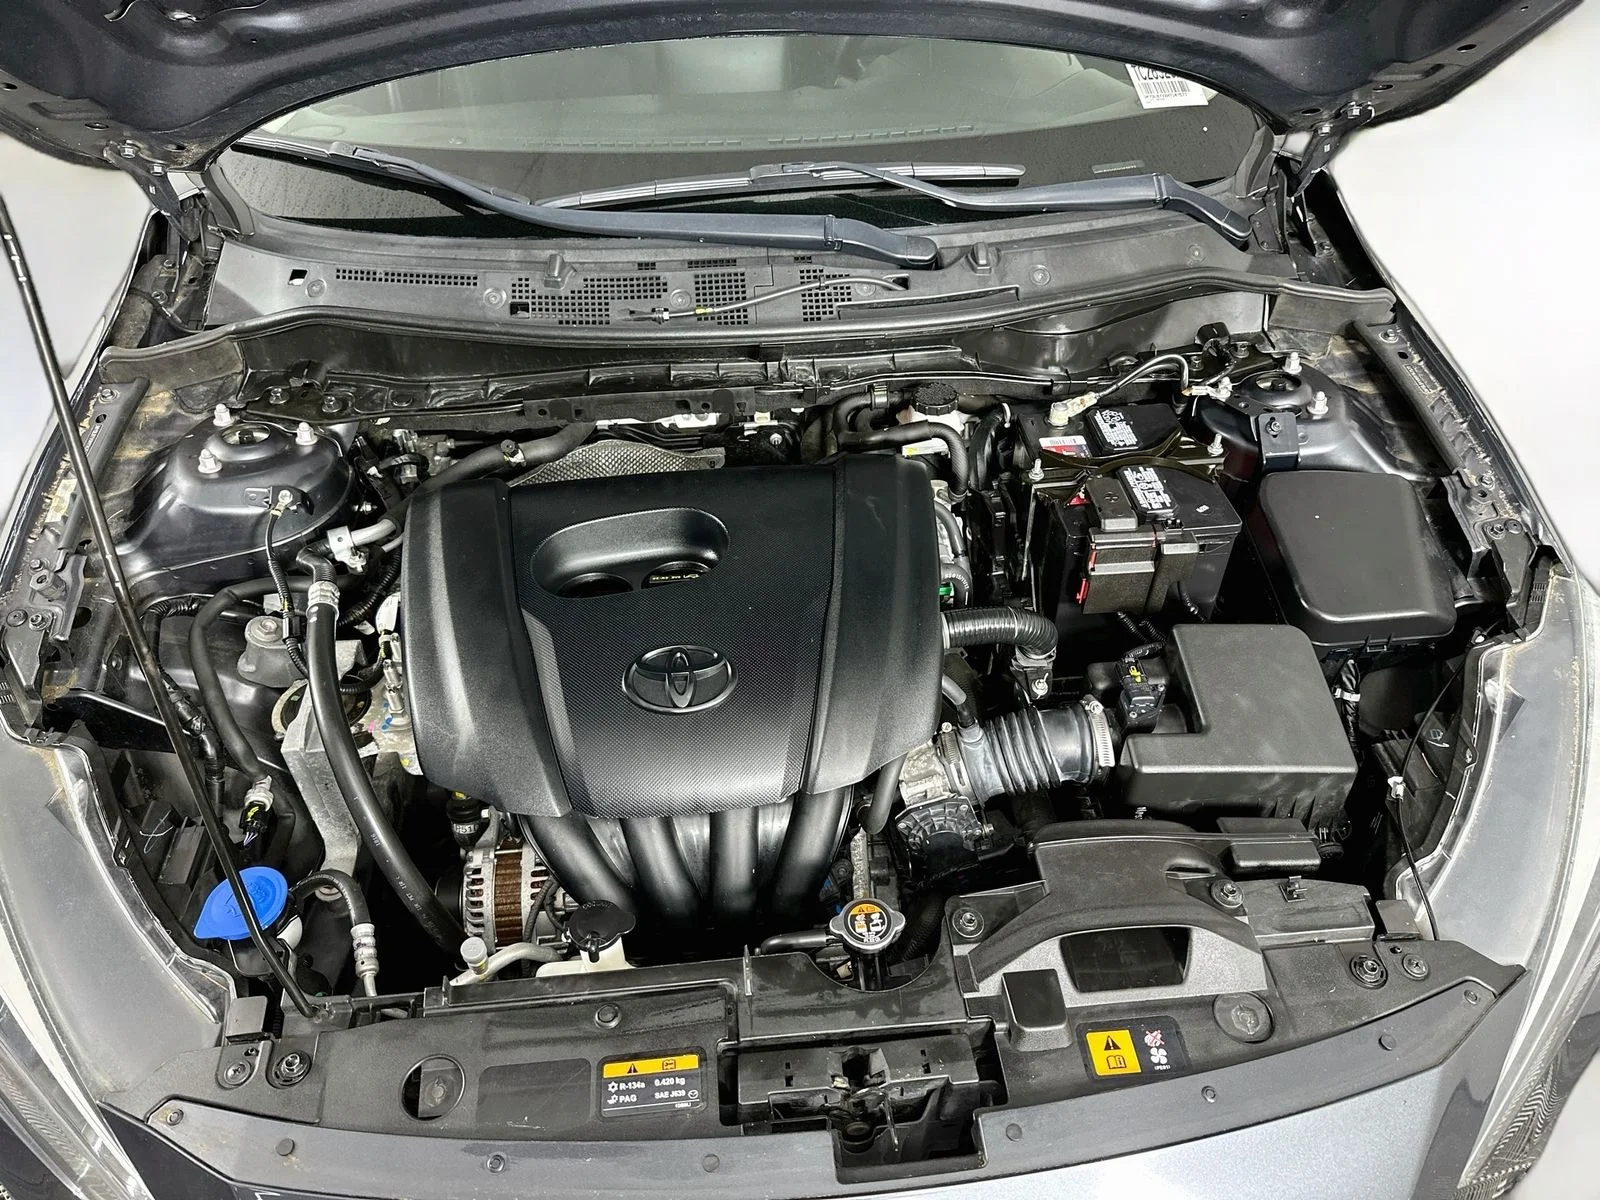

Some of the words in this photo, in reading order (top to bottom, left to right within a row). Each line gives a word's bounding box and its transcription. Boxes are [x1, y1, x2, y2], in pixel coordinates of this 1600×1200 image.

[619, 1082, 645, 1090] R-134a
[675, 1077, 685, 1085] kg
[619, 1094, 637, 1103] PAG
[654, 1091, 669, 1100] SAE
